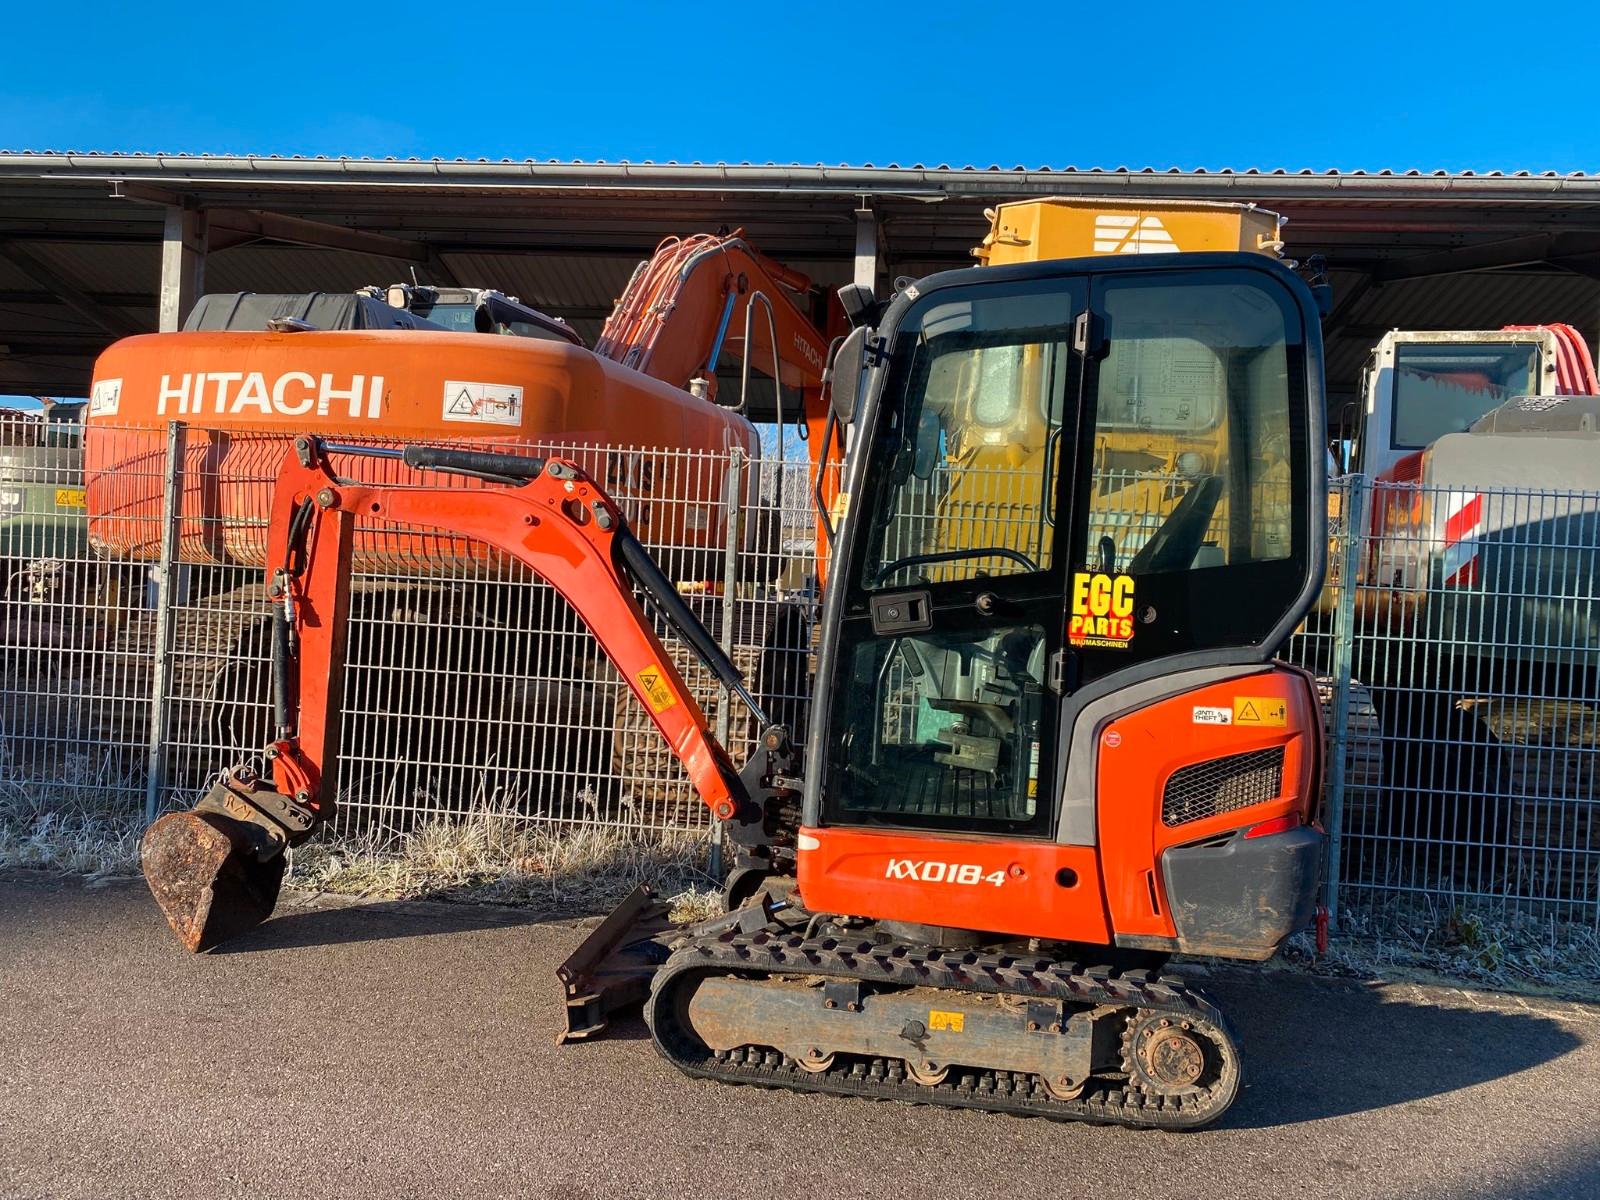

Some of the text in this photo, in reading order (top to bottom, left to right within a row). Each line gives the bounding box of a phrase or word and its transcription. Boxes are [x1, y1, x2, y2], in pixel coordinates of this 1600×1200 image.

[157, 371, 385, 419] HITACHI
[1072, 573, 1135, 618] EGC
[1071, 616, 1132, 637] PARTS
[1070, 638, 1129, 649] BAUMASCHINEN
[885, 858, 1006, 887] KX018-4
